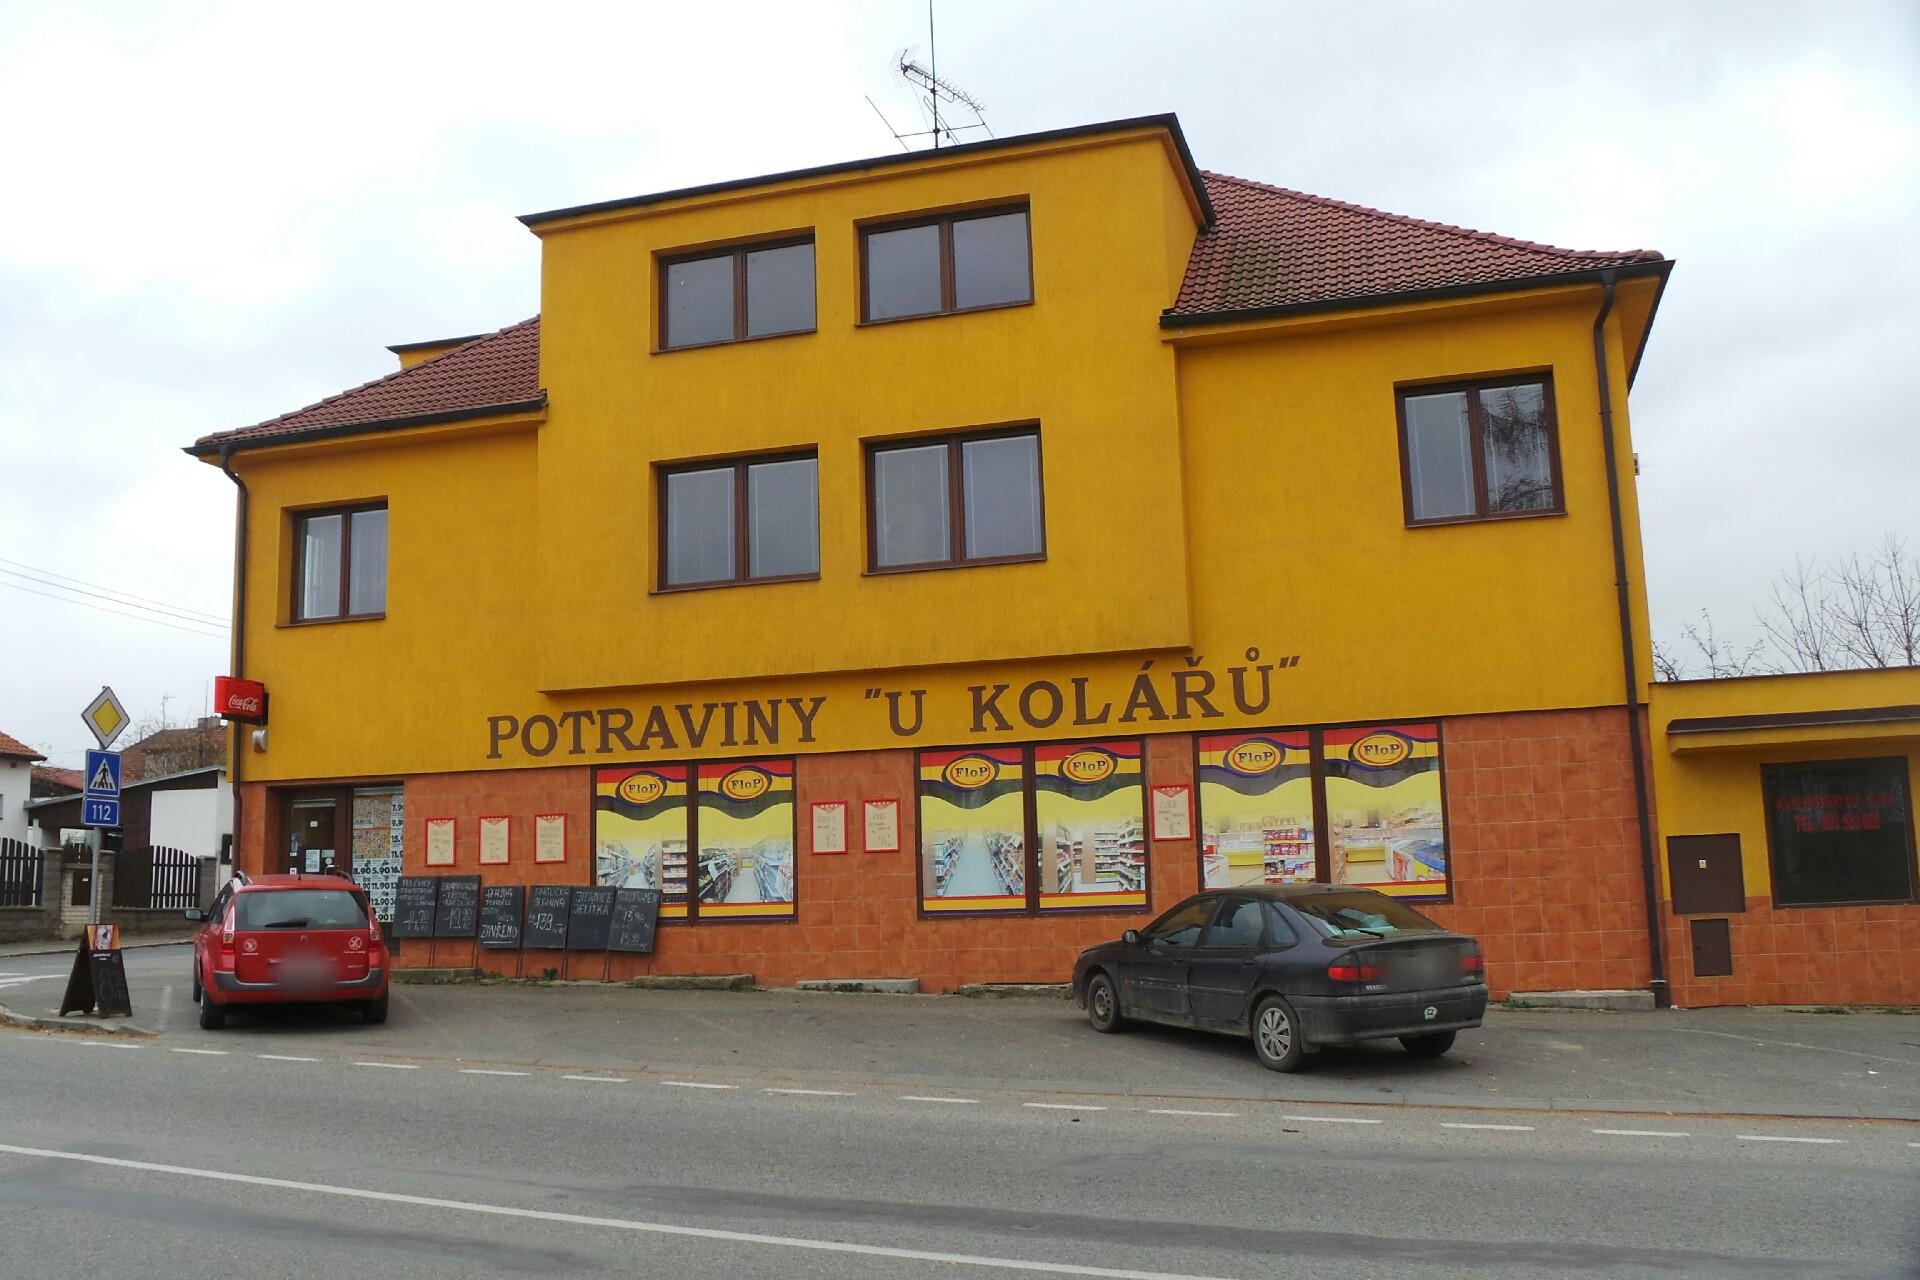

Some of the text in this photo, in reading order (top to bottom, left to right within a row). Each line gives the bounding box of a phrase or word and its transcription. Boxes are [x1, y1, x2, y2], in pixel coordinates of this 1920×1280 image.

[486, 646, 1301, 760] POTRAVINY "U KOLÁŘŮ"
[92, 804, 111, 821] 112
